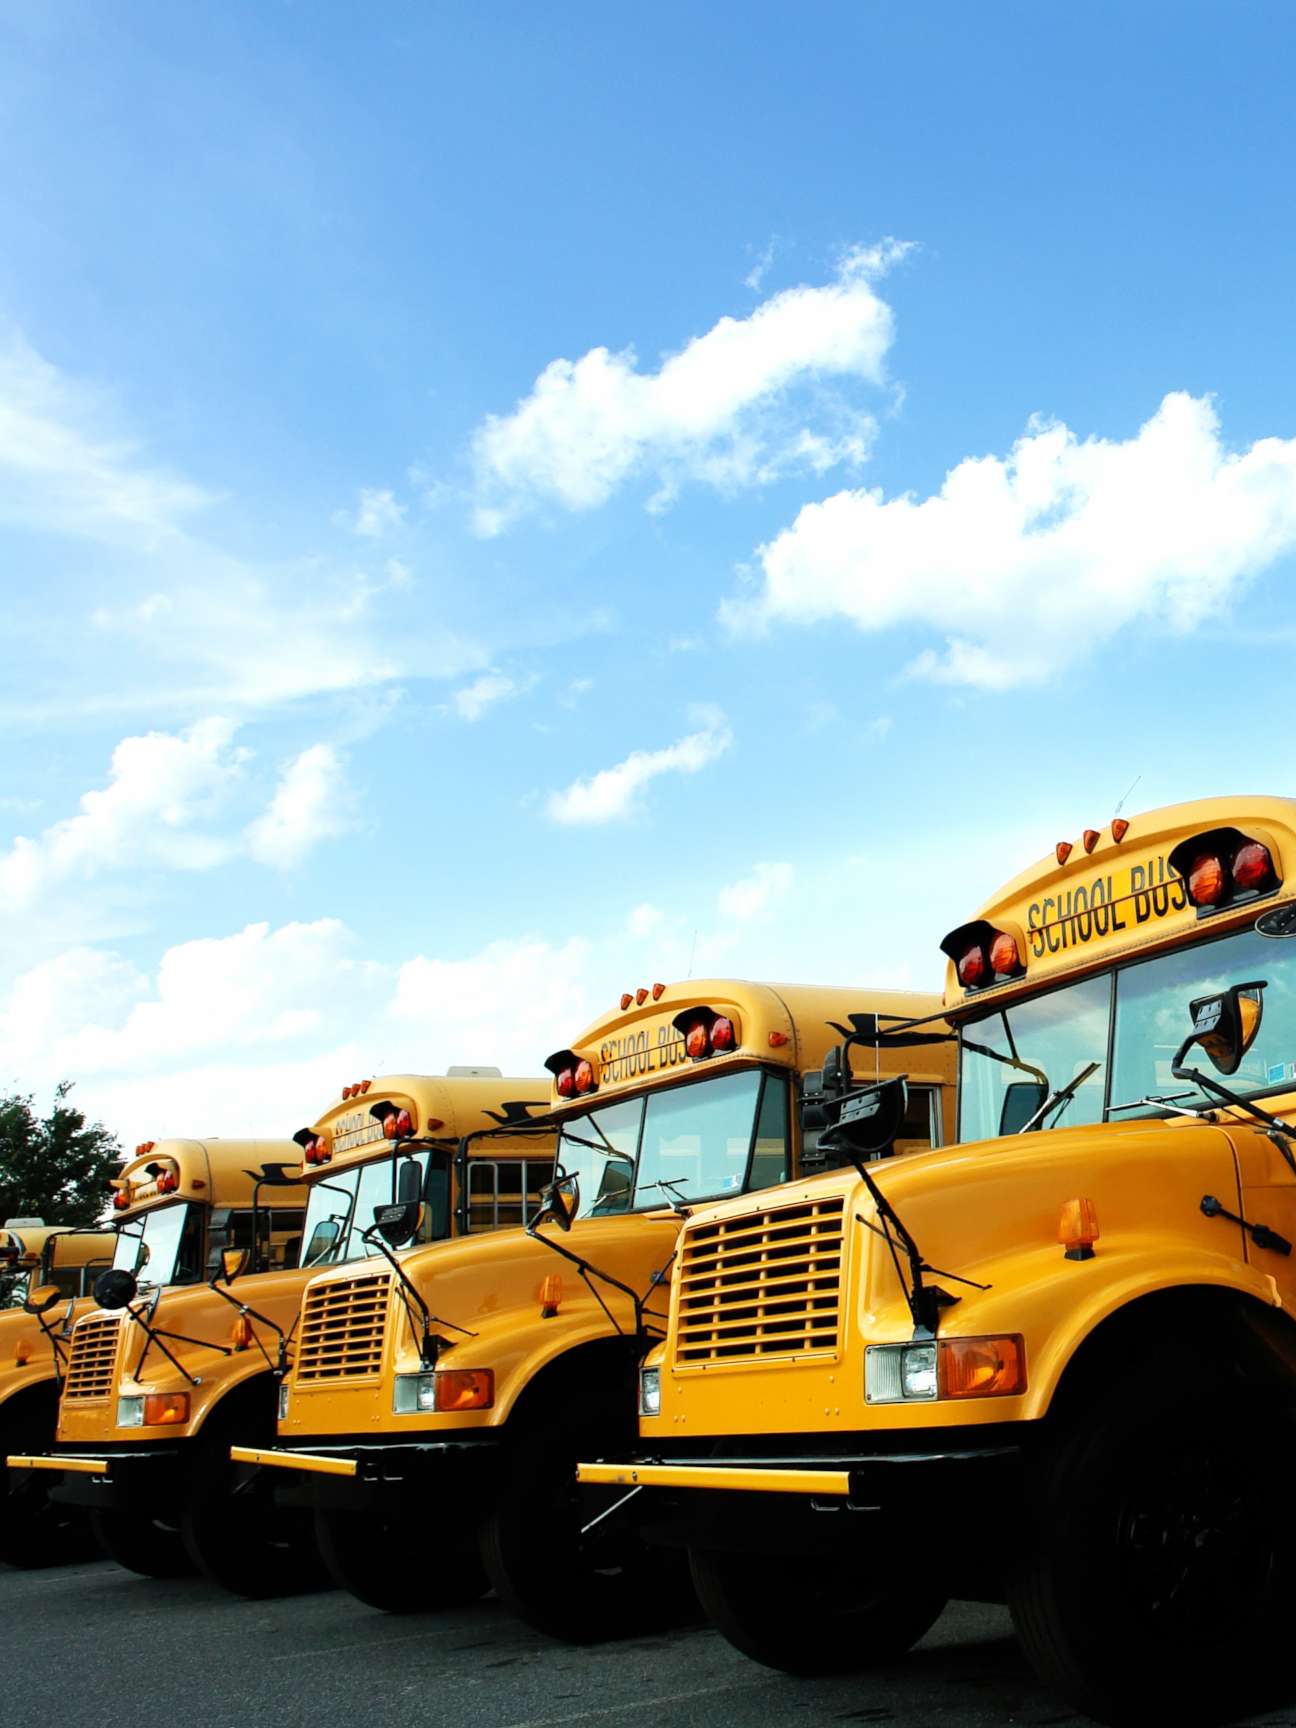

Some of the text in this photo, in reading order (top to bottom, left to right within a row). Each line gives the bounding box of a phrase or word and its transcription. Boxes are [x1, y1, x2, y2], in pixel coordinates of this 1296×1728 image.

[1028, 856, 1187, 958] SCHOOL BUS
[601, 1031, 655, 1084] SCHOOL
